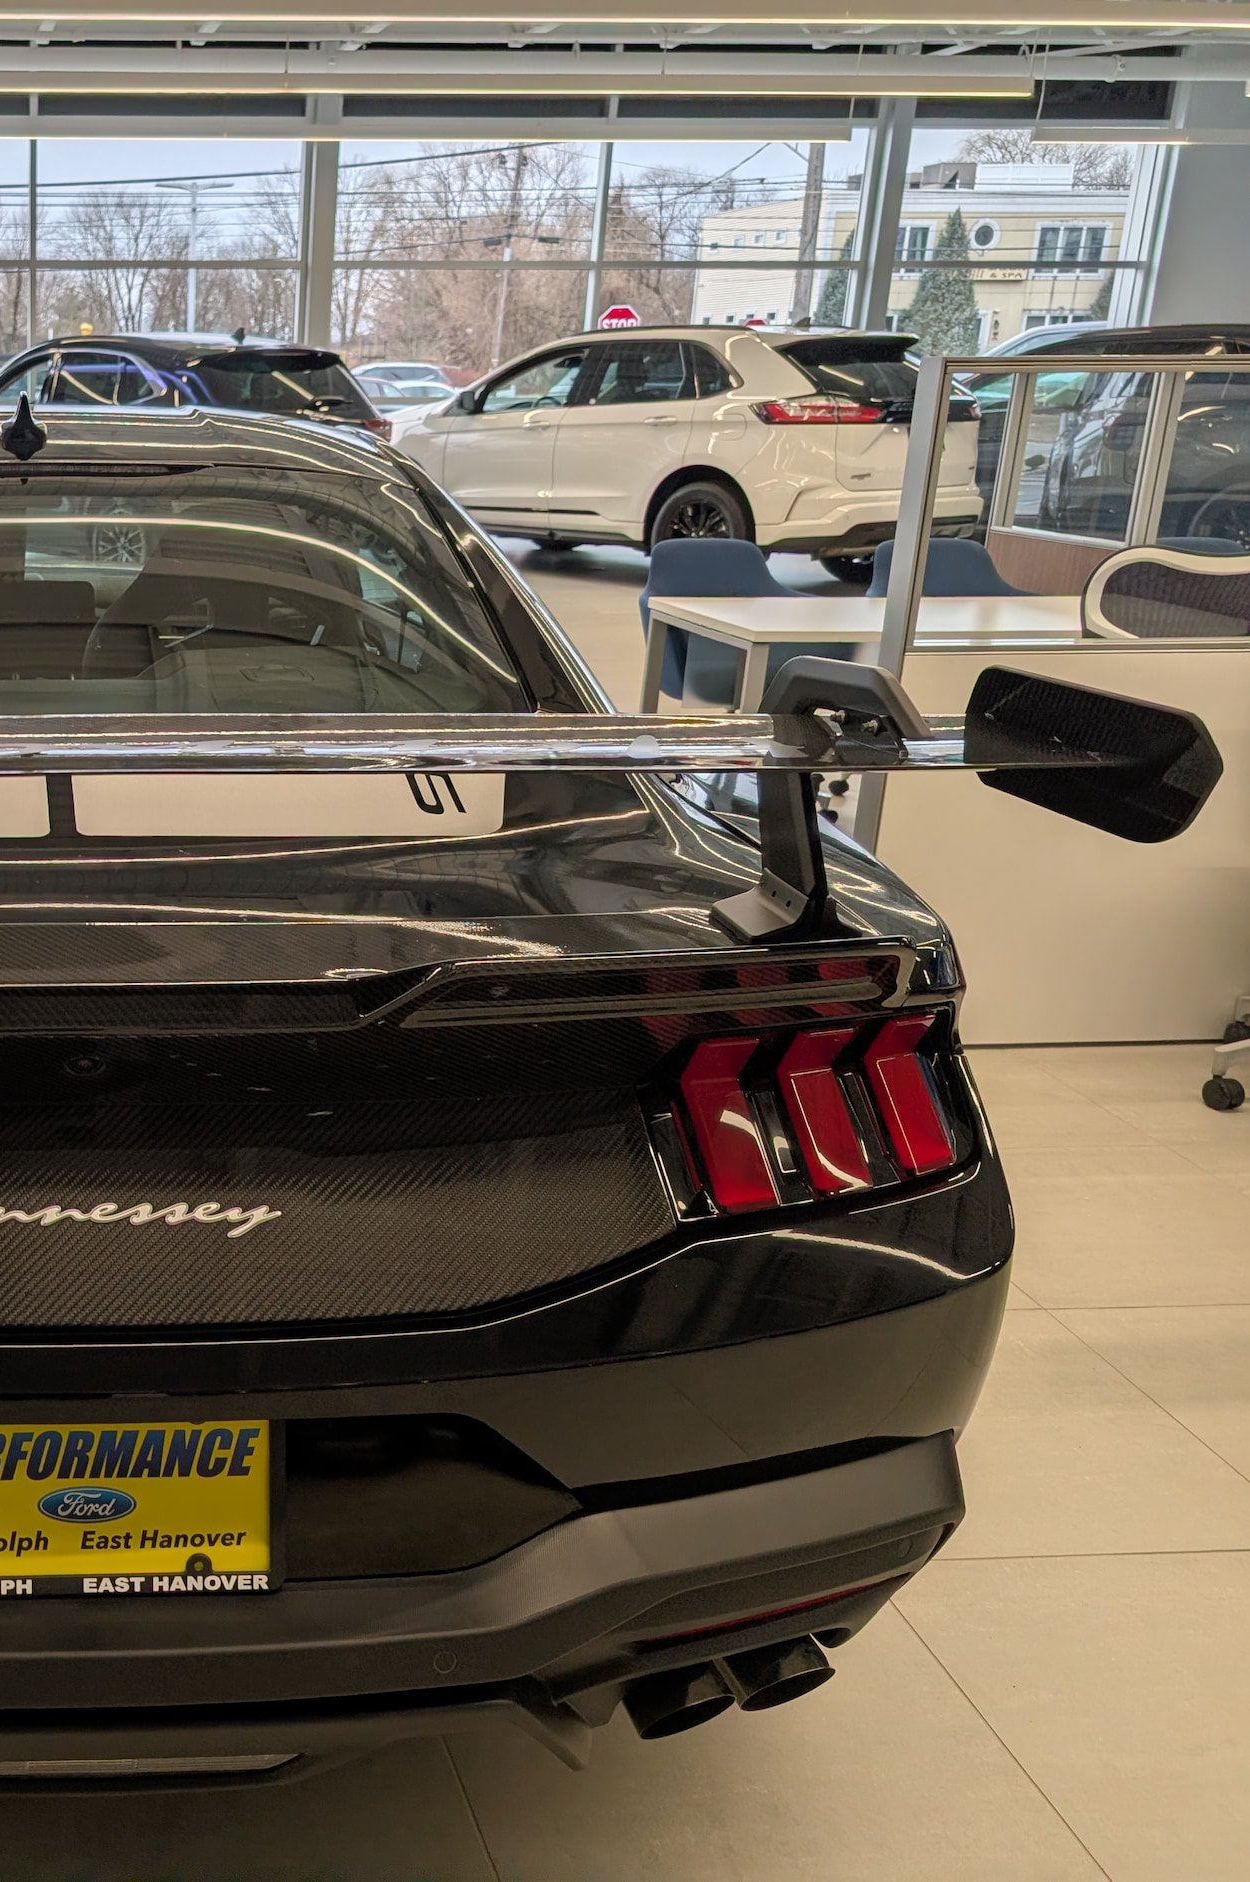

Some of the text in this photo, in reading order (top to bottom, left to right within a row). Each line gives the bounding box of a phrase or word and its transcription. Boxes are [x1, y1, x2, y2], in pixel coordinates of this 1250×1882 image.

[602, 317, 637, 329] STOP
[57, 1490, 117, 1518] Ford
[80, 1530, 247, 1550] East Hanover
[83, 1574, 269, 1594] EAST HANOVER
